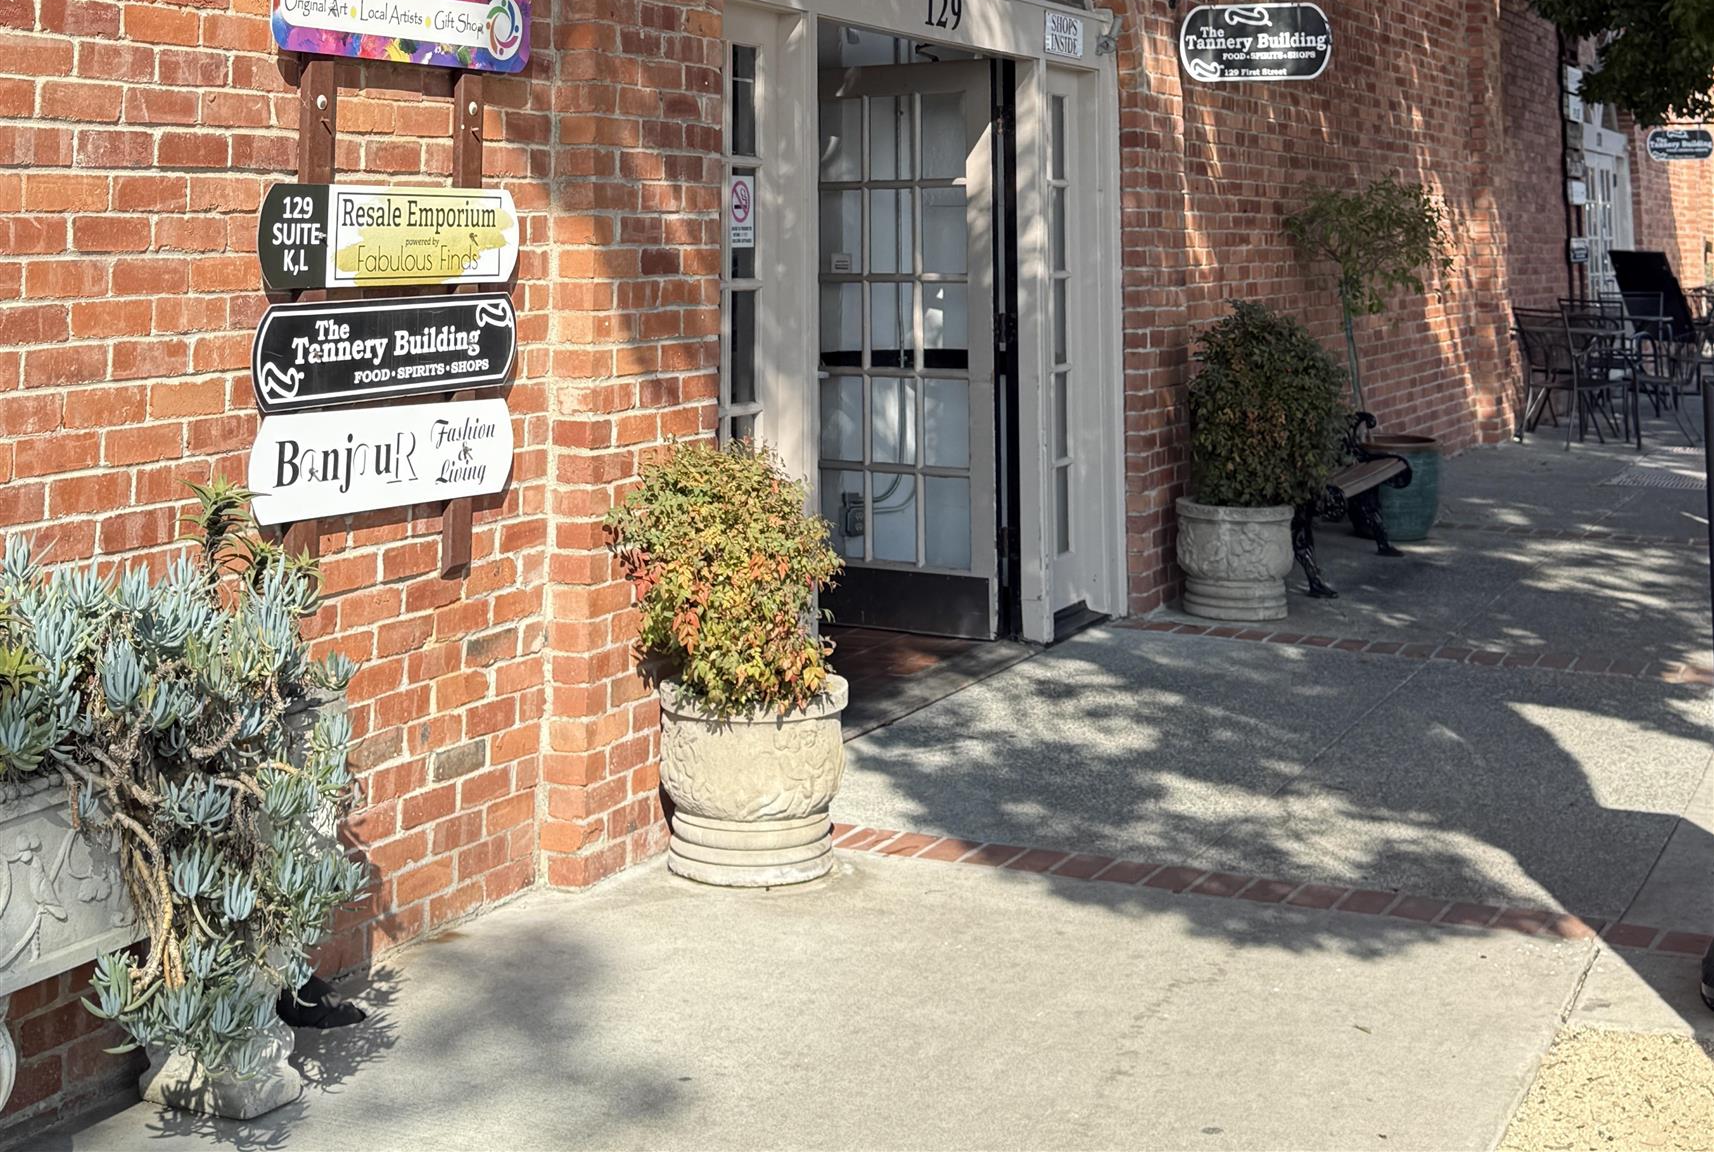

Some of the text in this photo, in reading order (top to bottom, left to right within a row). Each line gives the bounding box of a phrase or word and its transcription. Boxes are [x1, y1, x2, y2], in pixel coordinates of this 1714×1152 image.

[360, 0, 387, 22] Local
[389, 5, 423, 26] Artists
[434, 10, 455, 32] Gift
[457, 13, 483, 39] Shop
[1051, 14, 1078, 36] SHOPS
[1185, 32, 1327, 52] Tannery Building
[1200, 27, 1225, 38] The
[1050, 33, 1078, 56] INSIDE
[1241, 68, 1260, 76] First
[1262, 67, 1287, 76] Street
[282, 196, 313, 219] 129
[342, 198, 497, 235] Resale Emporium
[405, 237, 440, 248] powered by
[283, 249, 309, 276] K,L
[357, 244, 478, 273] Fabulous Finds
[315, 319, 350, 341] The
[292, 326, 481, 366] Tannery Building
[430, 417, 495, 449] Fashion
[435, 457, 487, 485] Living
